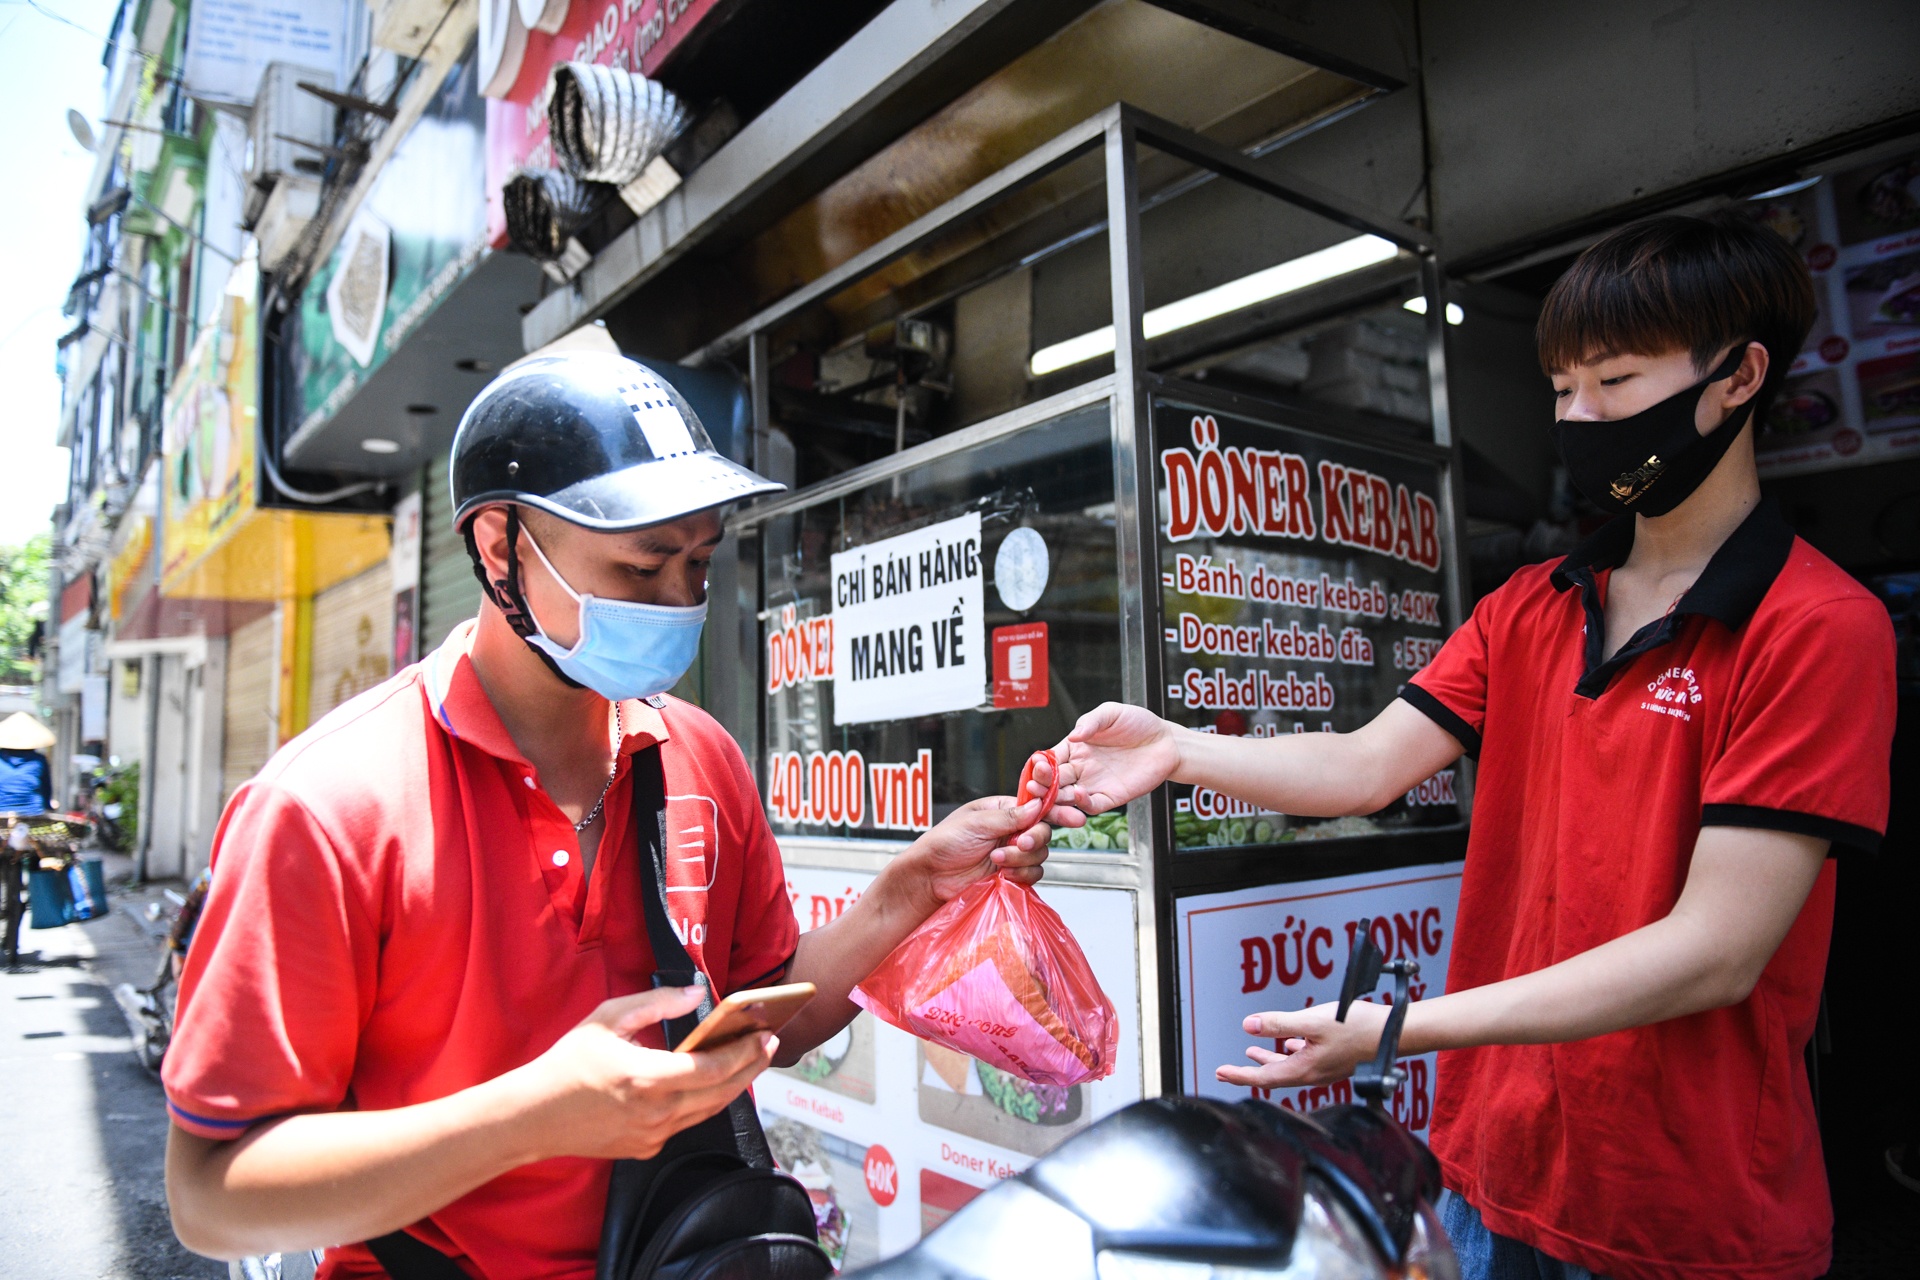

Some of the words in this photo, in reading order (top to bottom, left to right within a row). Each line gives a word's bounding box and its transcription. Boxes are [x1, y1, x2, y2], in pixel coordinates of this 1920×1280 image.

[1162, 416, 1316, 542] DÖNER
[1318, 460, 1440, 572] KEBAB
[837, 553, 866, 608] CHỈ
[873, 552, 911, 600] BÁN
[919, 538, 978, 589] HÀNG
[1250, 563, 1319, 608] doner
[1320, 573, 1388, 619] kebab
[768, 602, 833, 695] DÖNE
[851, 624, 924, 682] MANG
[932, 597, 966, 669] VỀ
[1179, 612, 1261, 657] Doner
[1262, 618, 1336, 663] kebab
[1183, 667, 1259, 710] Salad
[1259, 669, 1334, 711] kebab
[770, 750, 864, 826] 40.000
[869, 749, 932, 831] vnd
[1240, 915, 1333, 994] ĐỨC
[968, 1019, 1018, 1038] ONG
[811, 1098, 844, 1123] Kebab
[866, 1158, 895, 1195] 40K
[942, 1143, 984, 1173] Doner
